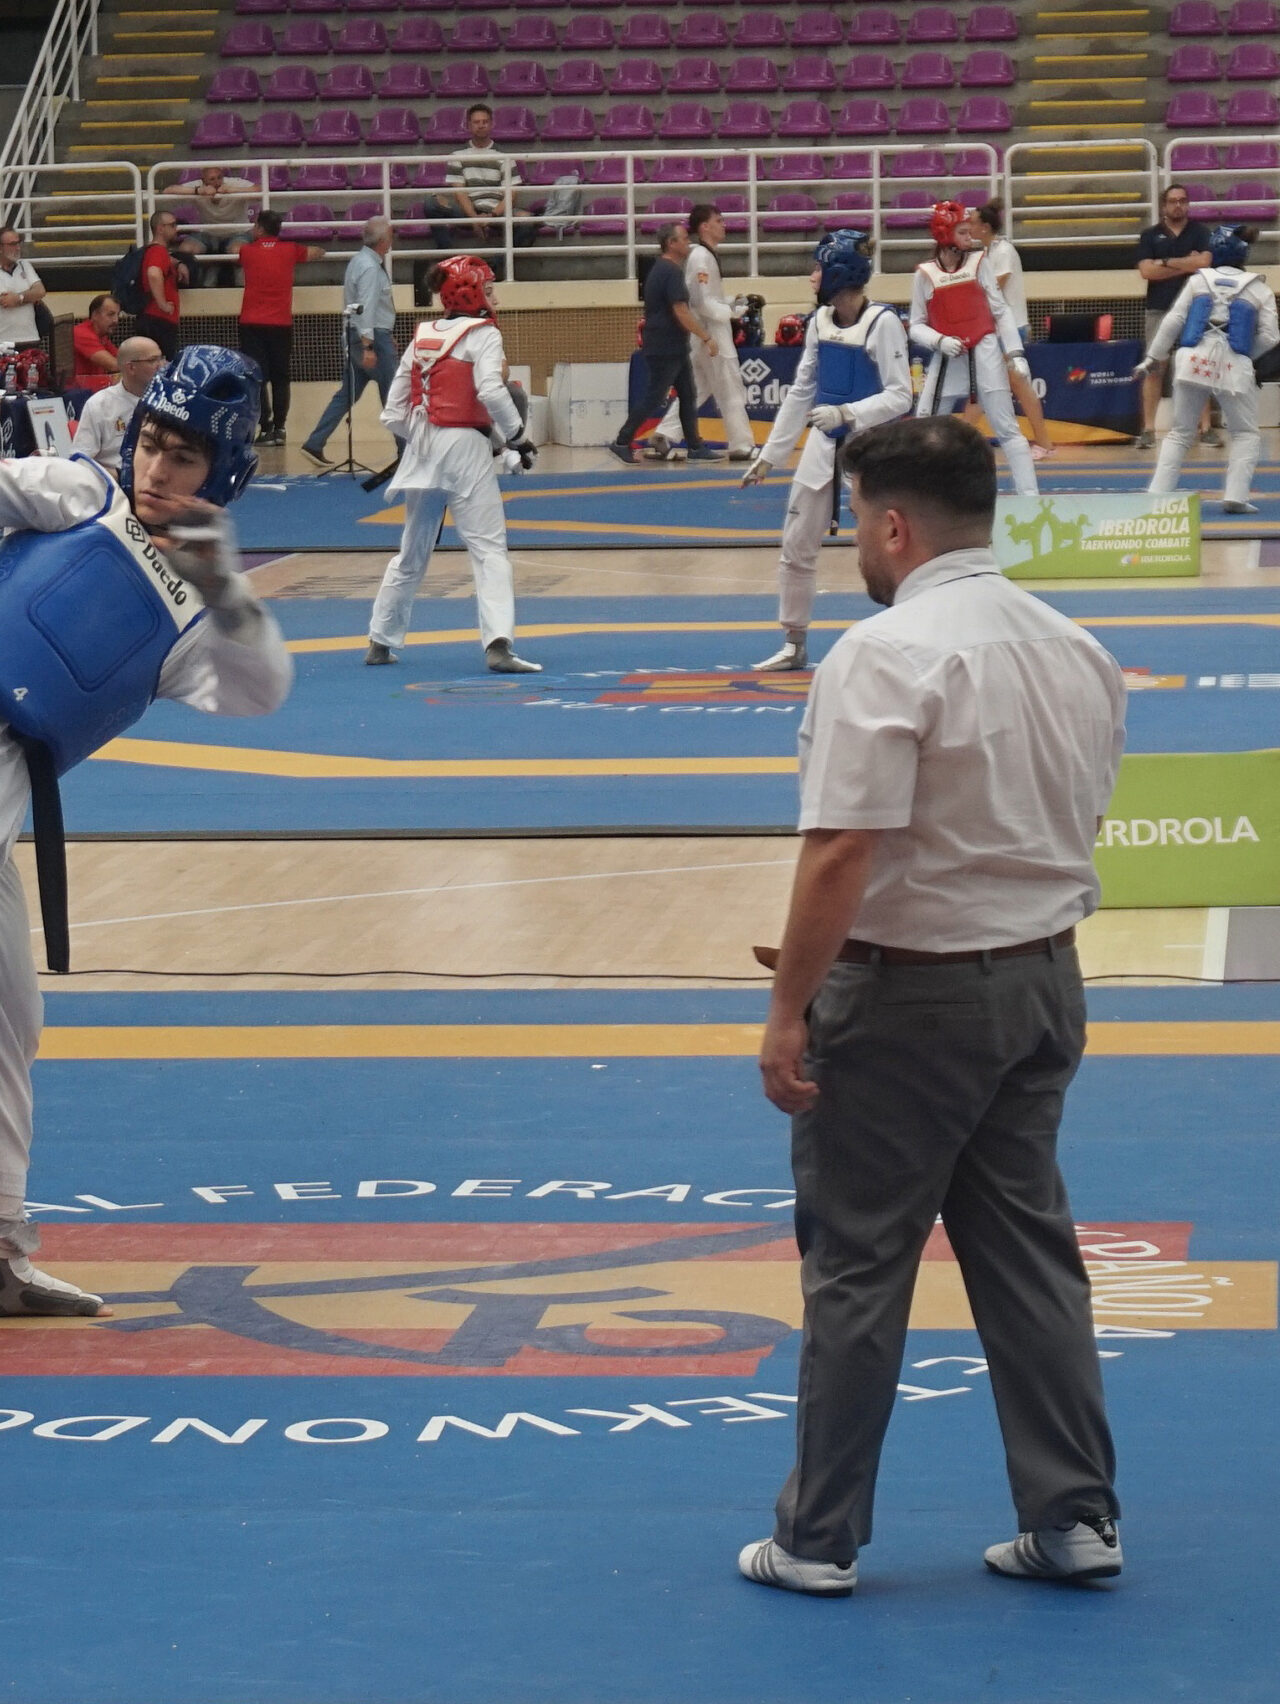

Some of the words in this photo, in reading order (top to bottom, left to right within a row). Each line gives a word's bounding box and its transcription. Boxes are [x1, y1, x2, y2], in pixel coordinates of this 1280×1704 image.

[745, 378, 792, 405] edo
[1152, 498, 1190, 514] LIGA
[1098, 516, 1190, 537] IBERDROLA
[1080, 538, 1142, 551] TAEKWONDO
[1144, 536, 1191, 549] COMBATE
[1140, 554, 1192, 563] IBERDROLA
[142, 544, 187, 606] Daedo
[190, 1178, 797, 1209] FEDERAC
[1074, 1224, 1235, 1339] PAÑOLA
